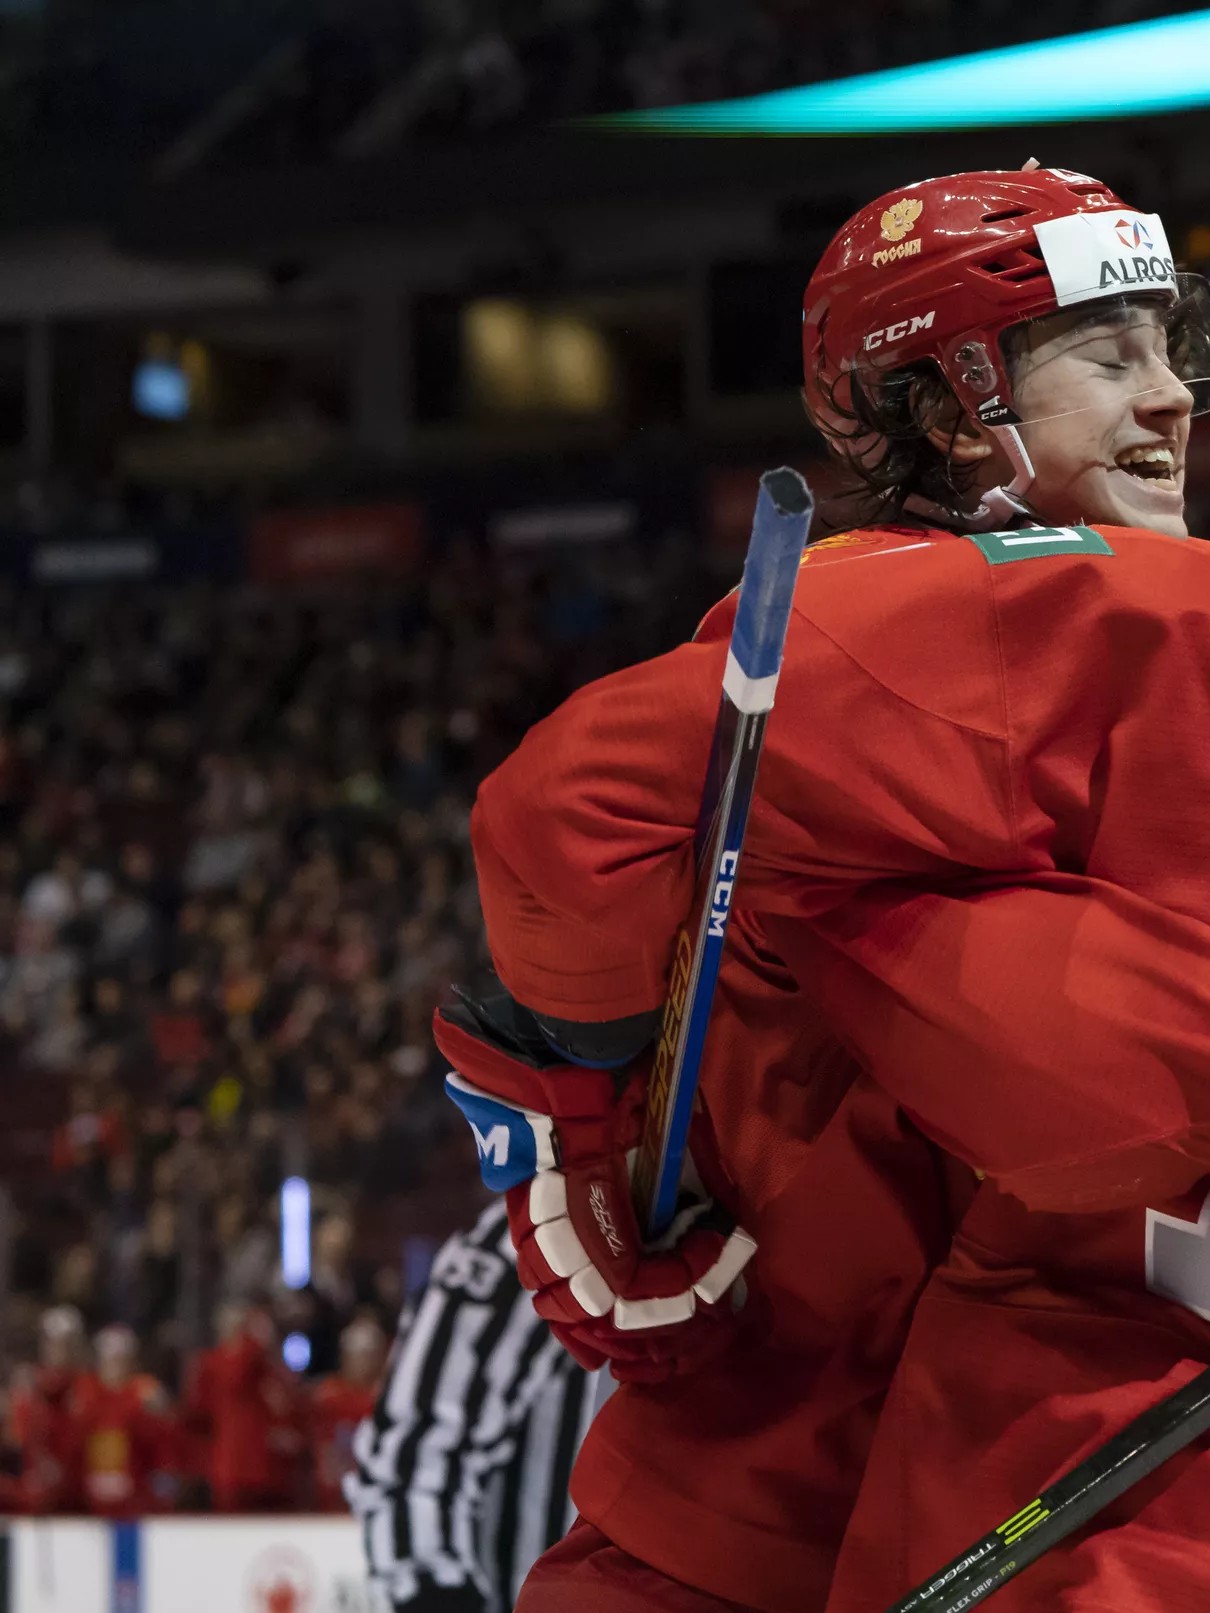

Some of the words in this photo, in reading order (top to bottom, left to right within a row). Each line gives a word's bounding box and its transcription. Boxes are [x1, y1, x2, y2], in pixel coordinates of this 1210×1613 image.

[863, 310, 935, 351] CCM
[981, 407, 1008, 420] CCM
[708, 849, 740, 937] CCM
[919, 1542, 997, 1600] TRIGGER
[971, 1577, 994, 1598] GRIP
[999, 1560, 1017, 1577] P19
